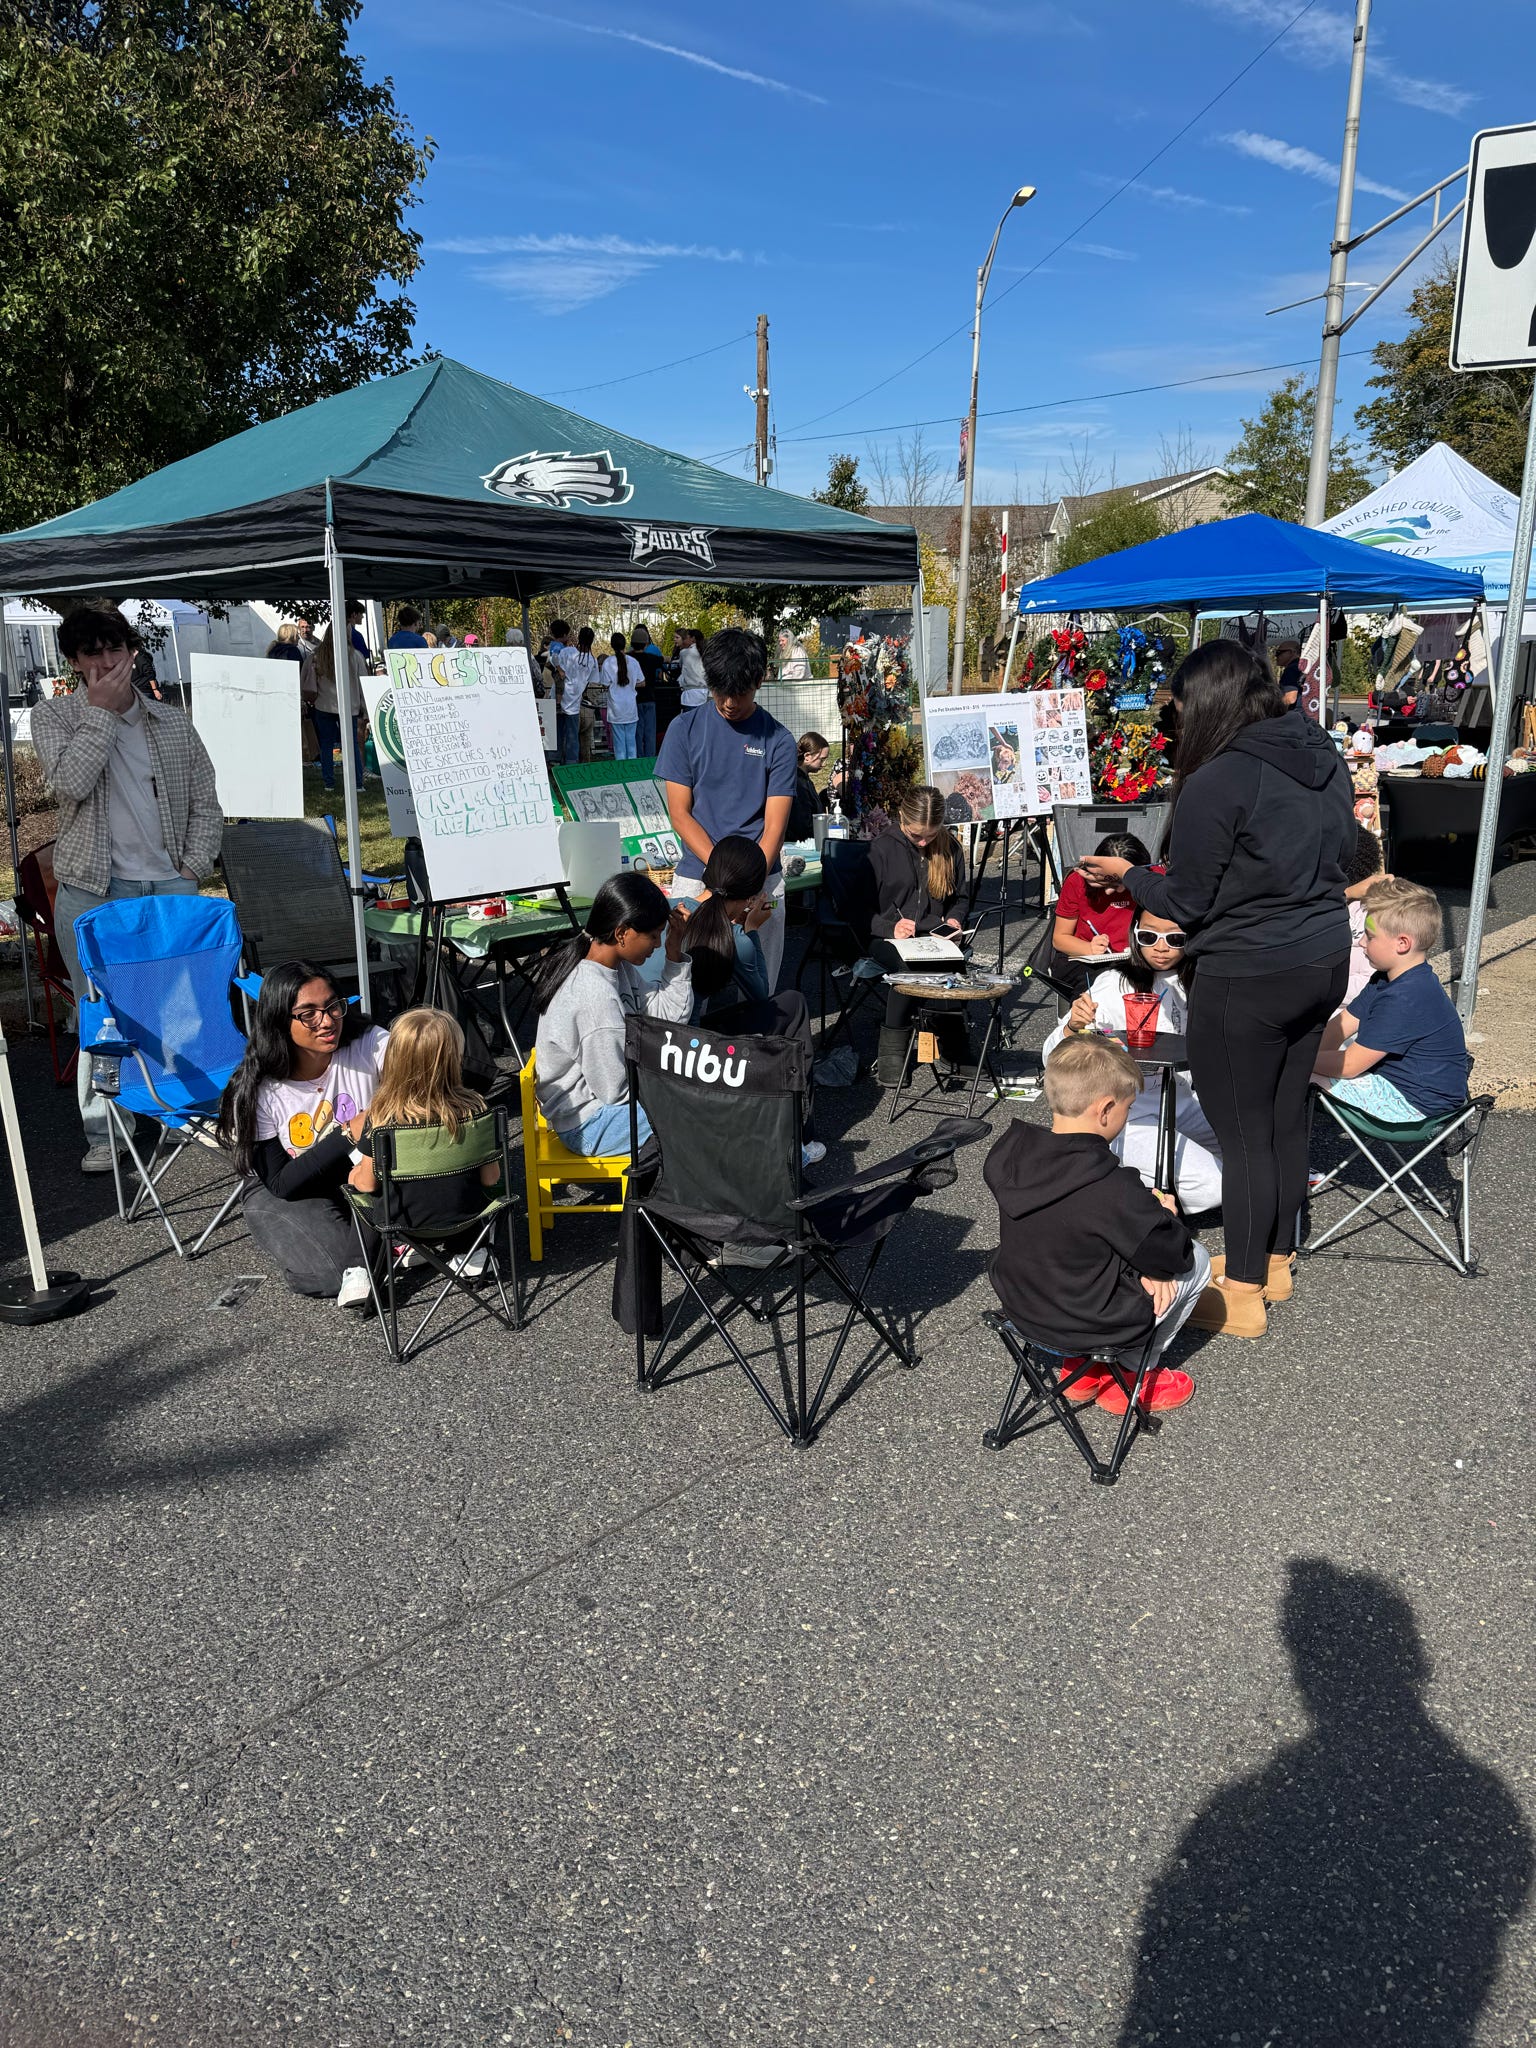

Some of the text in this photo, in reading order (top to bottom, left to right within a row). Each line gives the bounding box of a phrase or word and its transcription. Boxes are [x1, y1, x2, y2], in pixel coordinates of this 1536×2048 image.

[1412, 500, 1464, 523] COALITION
[1425, 528, 1437, 536] of
[631, 525, 713, 564] EAGLES
[389, 649, 487, 689] PRICES!
[396, 690, 433, 706] HENNA
[400, 707, 423, 719] SMALL
[401, 714, 423, 725] LARGE
[402, 720, 470, 738] FACE PAINTING
[403, 738, 430, 749] SMALL
[406, 745, 431, 757] LARGE
[410, 757, 432, 772] LIVE
[437, 750, 484, 767] SKETCHES
[496, 759, 532, 770] MONEY IS
[413, 772, 453, 792] WATER
[453, 766, 490, 780] TATTOO
[498, 764, 539, 778] NEGOTIABLE
[416, 788, 475, 820] CASH
[484, 776, 549, 807] CREDIT
[465, 803, 548, 835] ACCEPTED
